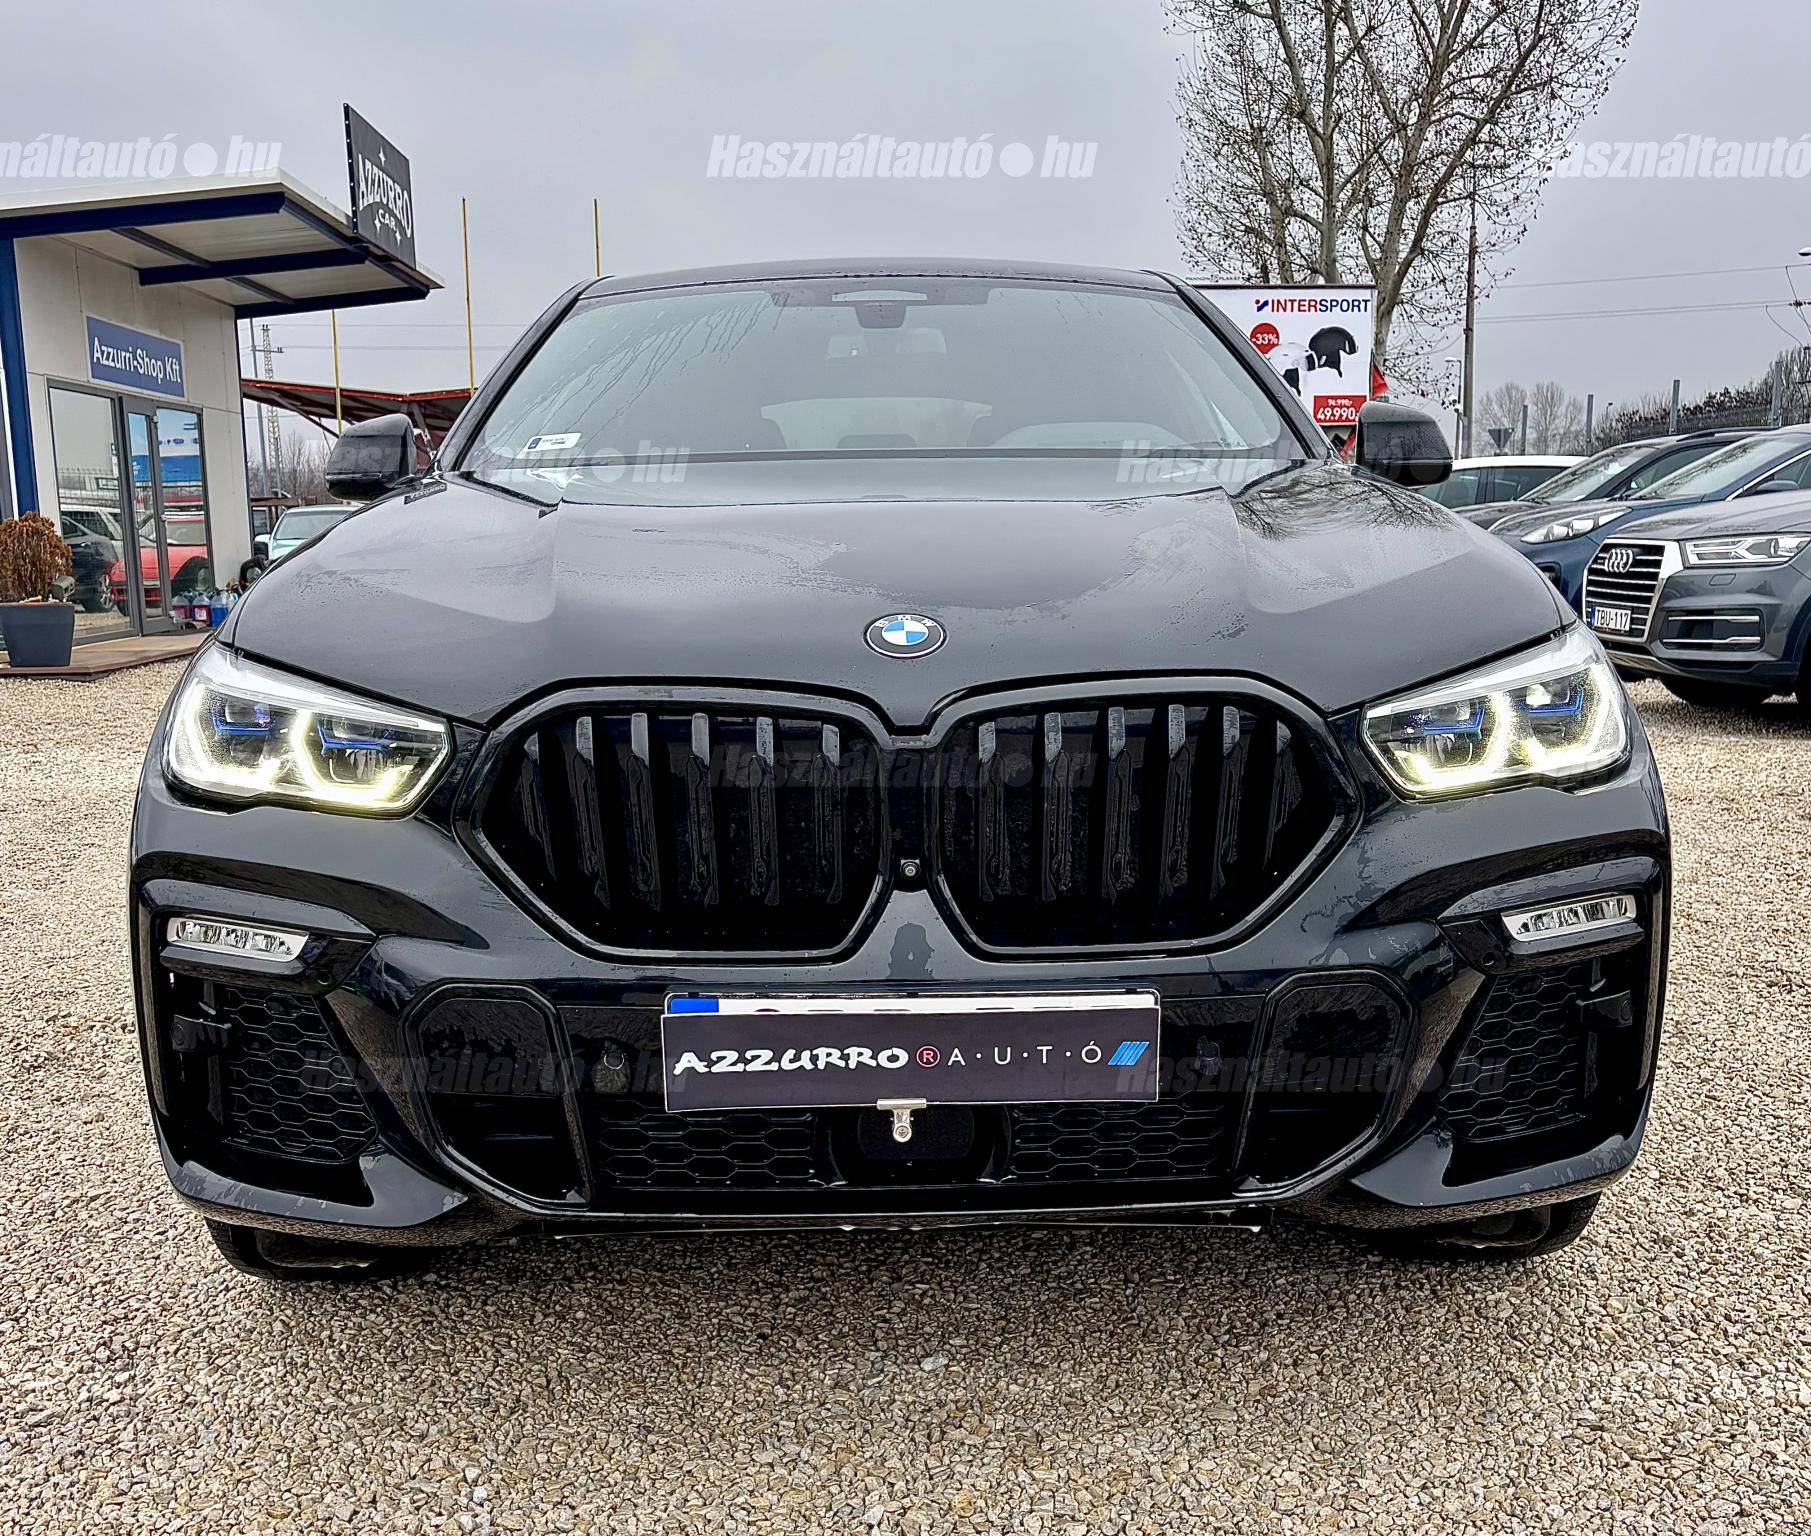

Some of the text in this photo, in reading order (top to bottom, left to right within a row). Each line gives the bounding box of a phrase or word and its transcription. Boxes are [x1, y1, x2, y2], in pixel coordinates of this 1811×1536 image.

[358, 153, 412, 238] AZZURRO
[379, 208, 397, 231] CAR
[1271, 298, 1371, 313] INTERSPORT
[1251, 333, 1279, 345] -33%
[93, 336, 181, 384] Azzurri-Shop Kft
[1596, 609, 1629, 629] TBU-117
[673, 1046, 909, 1075] AZZURRO
